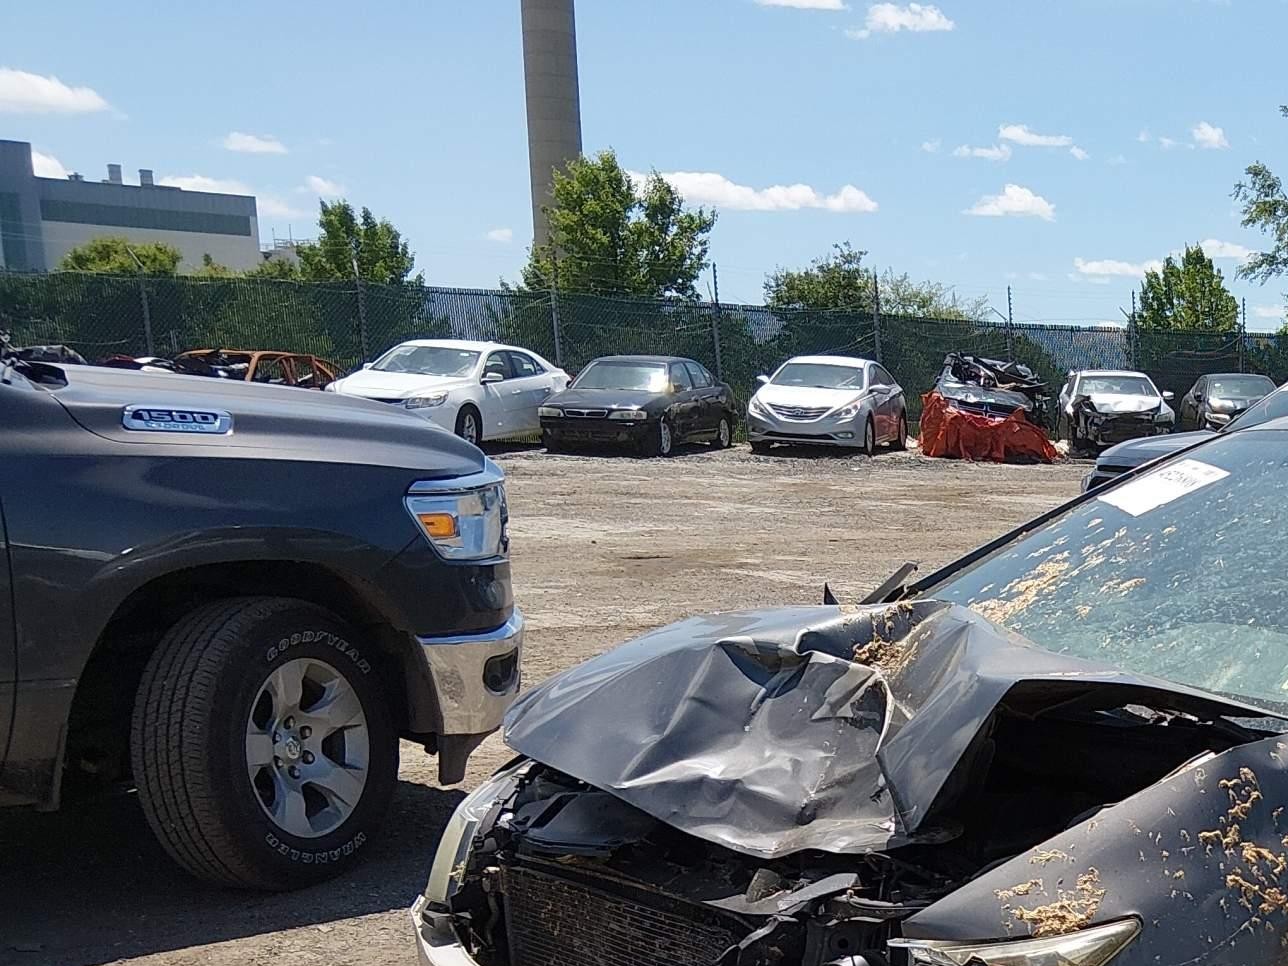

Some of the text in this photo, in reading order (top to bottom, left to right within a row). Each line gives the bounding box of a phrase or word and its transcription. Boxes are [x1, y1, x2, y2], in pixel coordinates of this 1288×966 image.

[134, 409, 218, 424] 1500
[266, 630, 371, 674] GOODYEAR
[265, 831, 367, 863] WRANGLER
